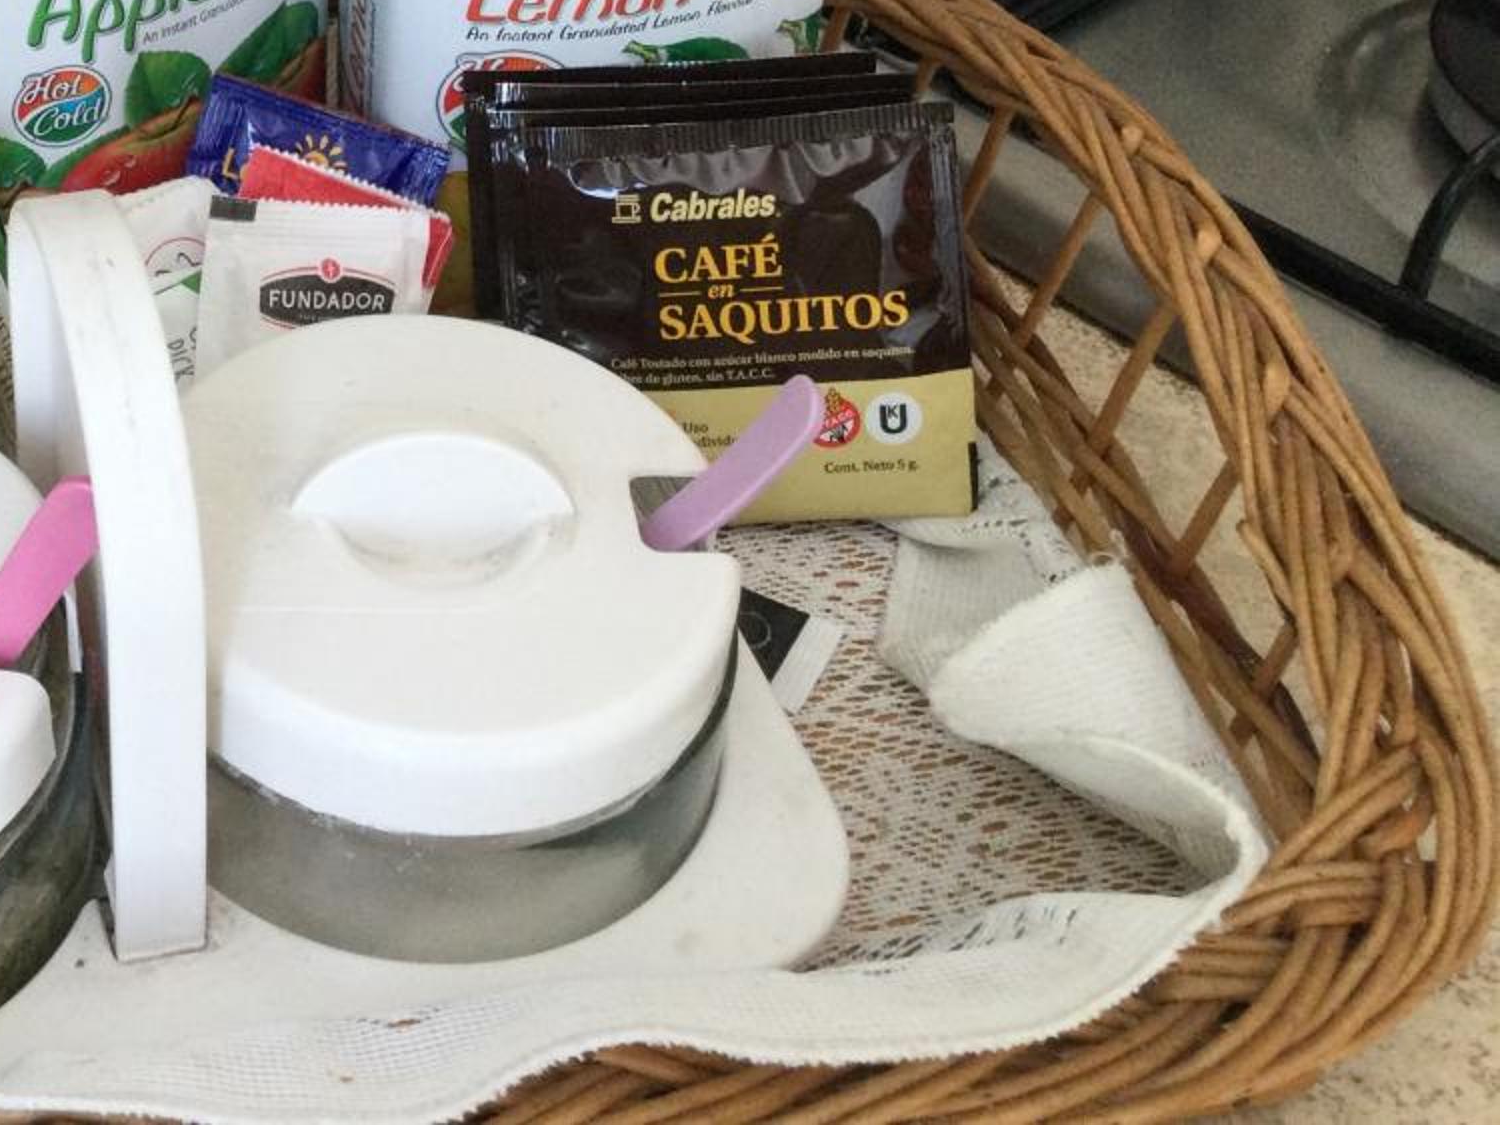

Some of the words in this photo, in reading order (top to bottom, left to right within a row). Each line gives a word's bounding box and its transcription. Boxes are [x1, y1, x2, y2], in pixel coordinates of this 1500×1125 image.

[143, 29, 159, 44] An
[465, 26, 489, 42] An
[496, 27, 555, 42] Instant
[559, 16, 649, 41] Granulated
[653, 9, 701, 30] Lemon
[23, 74, 82, 104] Hot
[33, 97, 102, 137] Cold
[650, 189, 776, 223] Cabrales
[654, 233, 784, 285] CAFÉ
[269, 288, 385, 312] FUNDADOR
[707, 282, 736, 300] en
[658, 290, 909, 344] SAQUITOS
[863, 458, 896, 472] Neto
